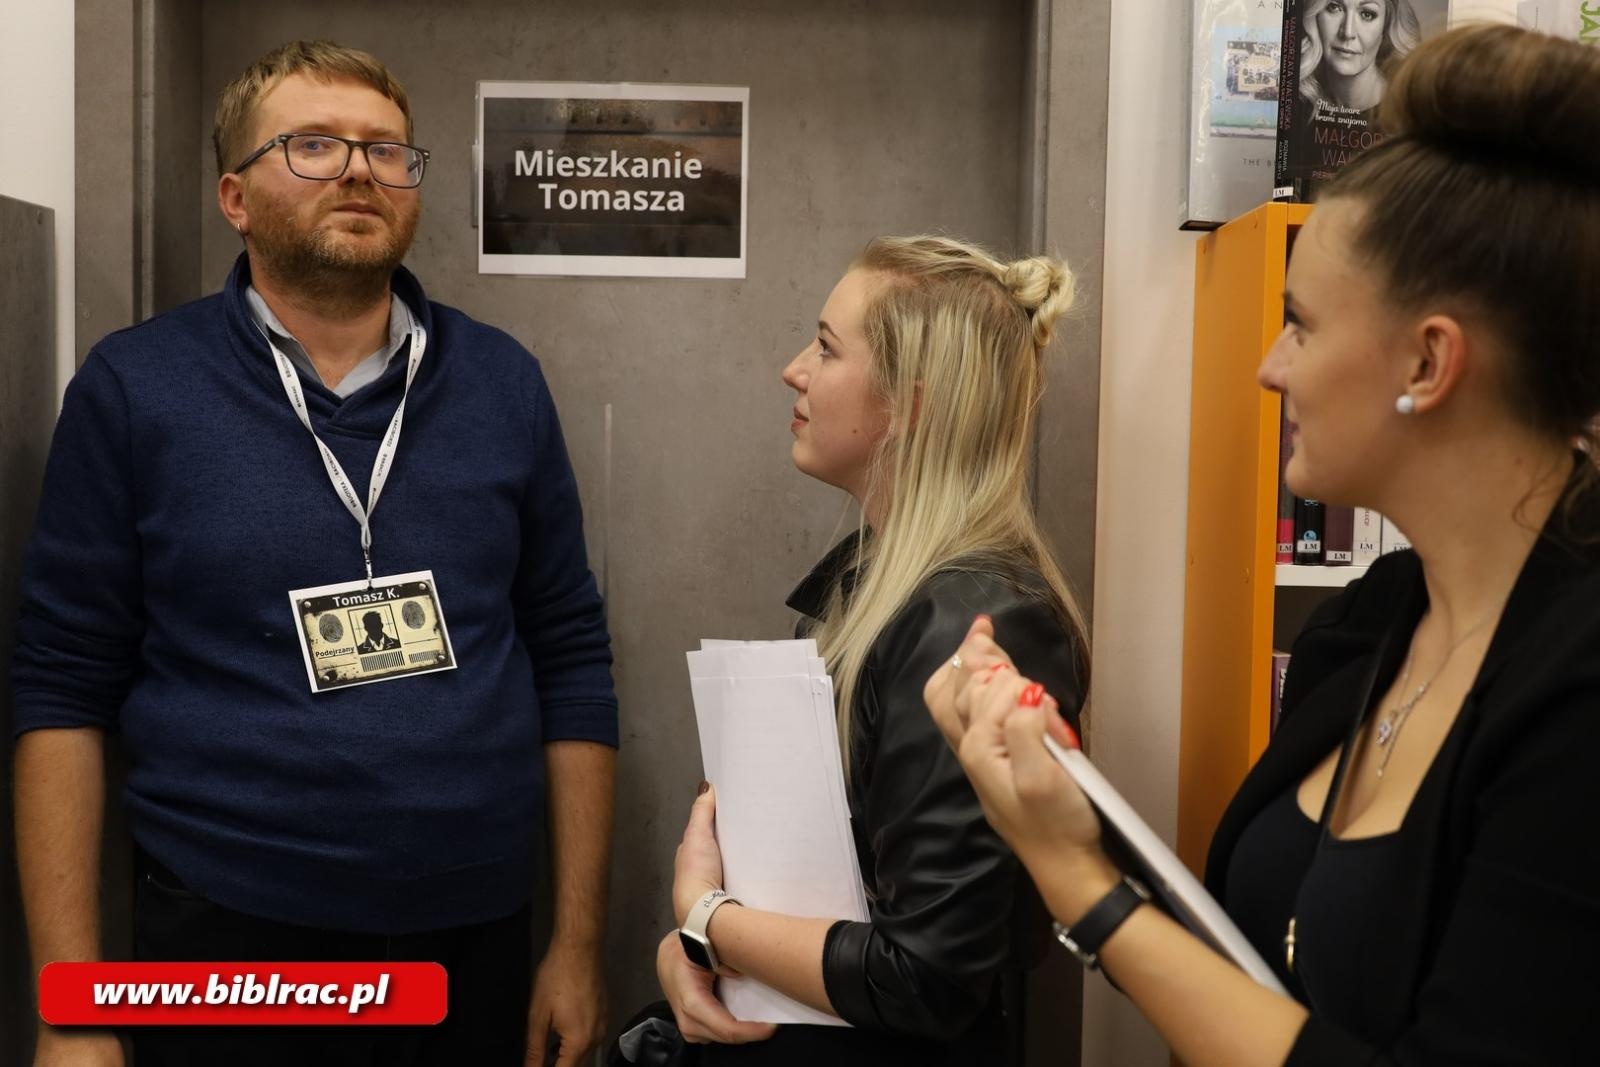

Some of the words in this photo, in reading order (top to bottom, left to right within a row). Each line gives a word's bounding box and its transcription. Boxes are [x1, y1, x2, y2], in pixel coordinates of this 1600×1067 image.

[1287, 16, 1296, 77] MAŁGORZATA
[1284, 79, 1293, 130] WALEWSKA
[1316, 98, 1339, 116] Maja
[1341, 105, 1360, 115] twarz
[1315, 111, 1335, 123] brzmi
[1338, 116, 1368, 129] znajomo
[514, 149, 703, 180] Mieszkanie
[537, 183, 686, 212] Tomasza
[1334, 552, 1346, 560] LM
[332, 590, 385, 608] Tomasz
[387, 587, 400, 599] K.
[315, 646, 355, 658] Podejrzany
